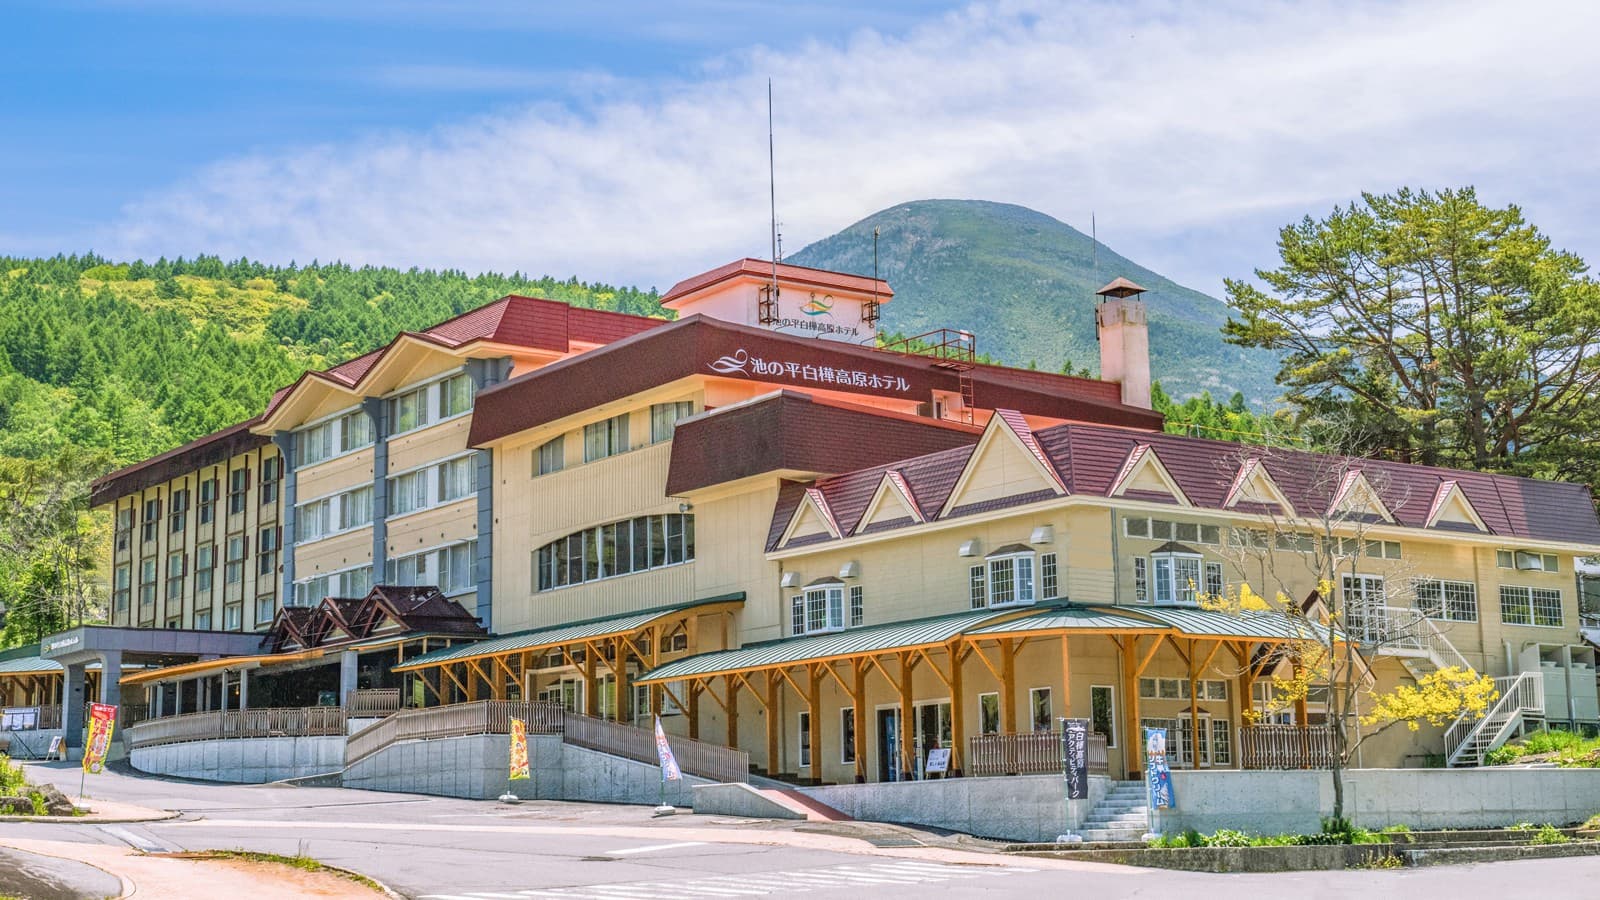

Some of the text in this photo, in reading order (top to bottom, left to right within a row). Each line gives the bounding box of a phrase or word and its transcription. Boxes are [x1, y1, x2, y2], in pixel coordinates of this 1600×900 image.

[750, 357, 911, 392] 池の平白樺高原ホテル
